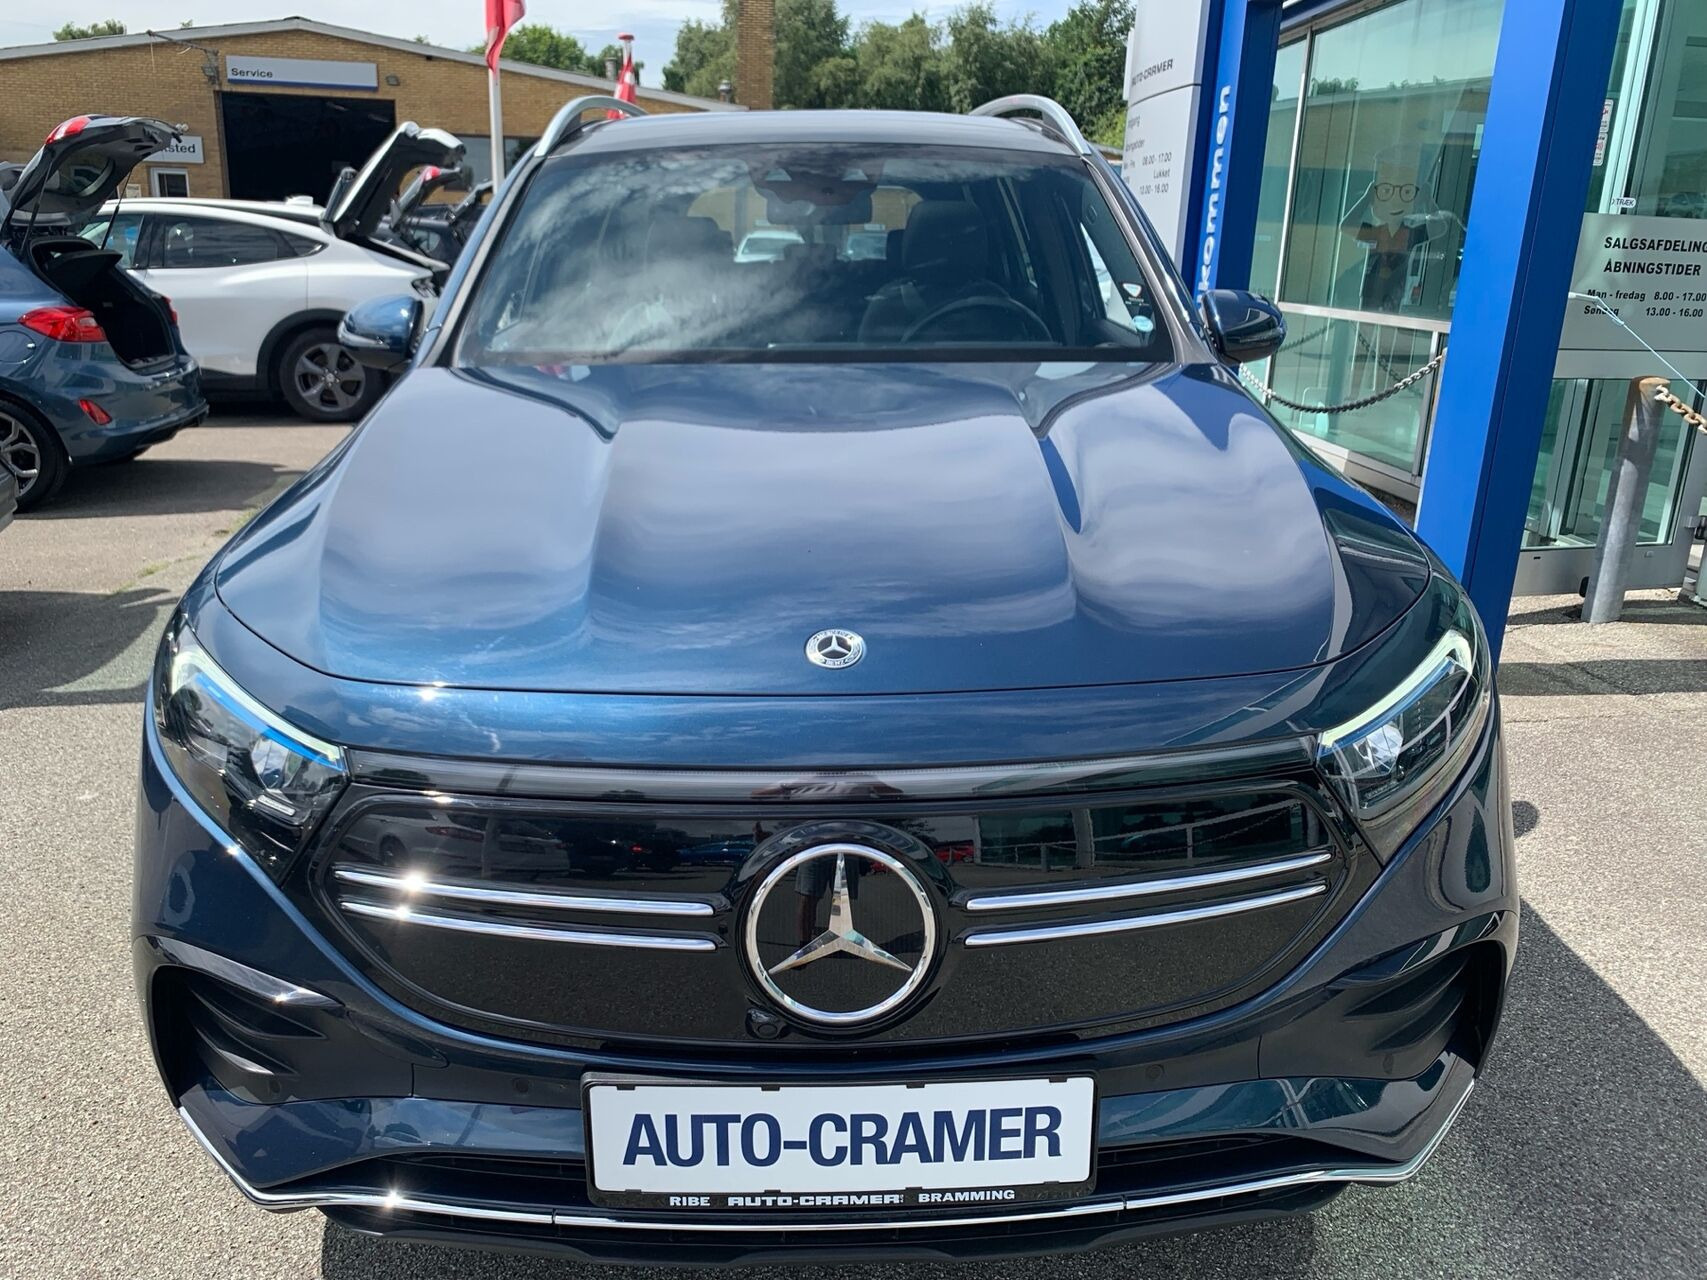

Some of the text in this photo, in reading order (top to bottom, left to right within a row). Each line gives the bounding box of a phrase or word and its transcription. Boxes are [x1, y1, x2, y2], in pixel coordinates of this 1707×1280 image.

[231, 67, 273, 78] Service
[1603, 258, 1702, 276] ÅBNINGSTIDER
[1587, 289, 1607, 299] Man
[1615, 290, 1646, 302] fredag
[1654, 291, 1674, 301] 8.00
[1682, 292, 1707, 302] 17.00
[1646, 307, 1671, 317] 13.00
[1680, 308, 1704, 318] 16.00
[622, 1106, 1062, 1167] AUTO-CRAMER
[669, 1189, 1015, 1207] RIBE AUTO-CRAMER BRAMMING
